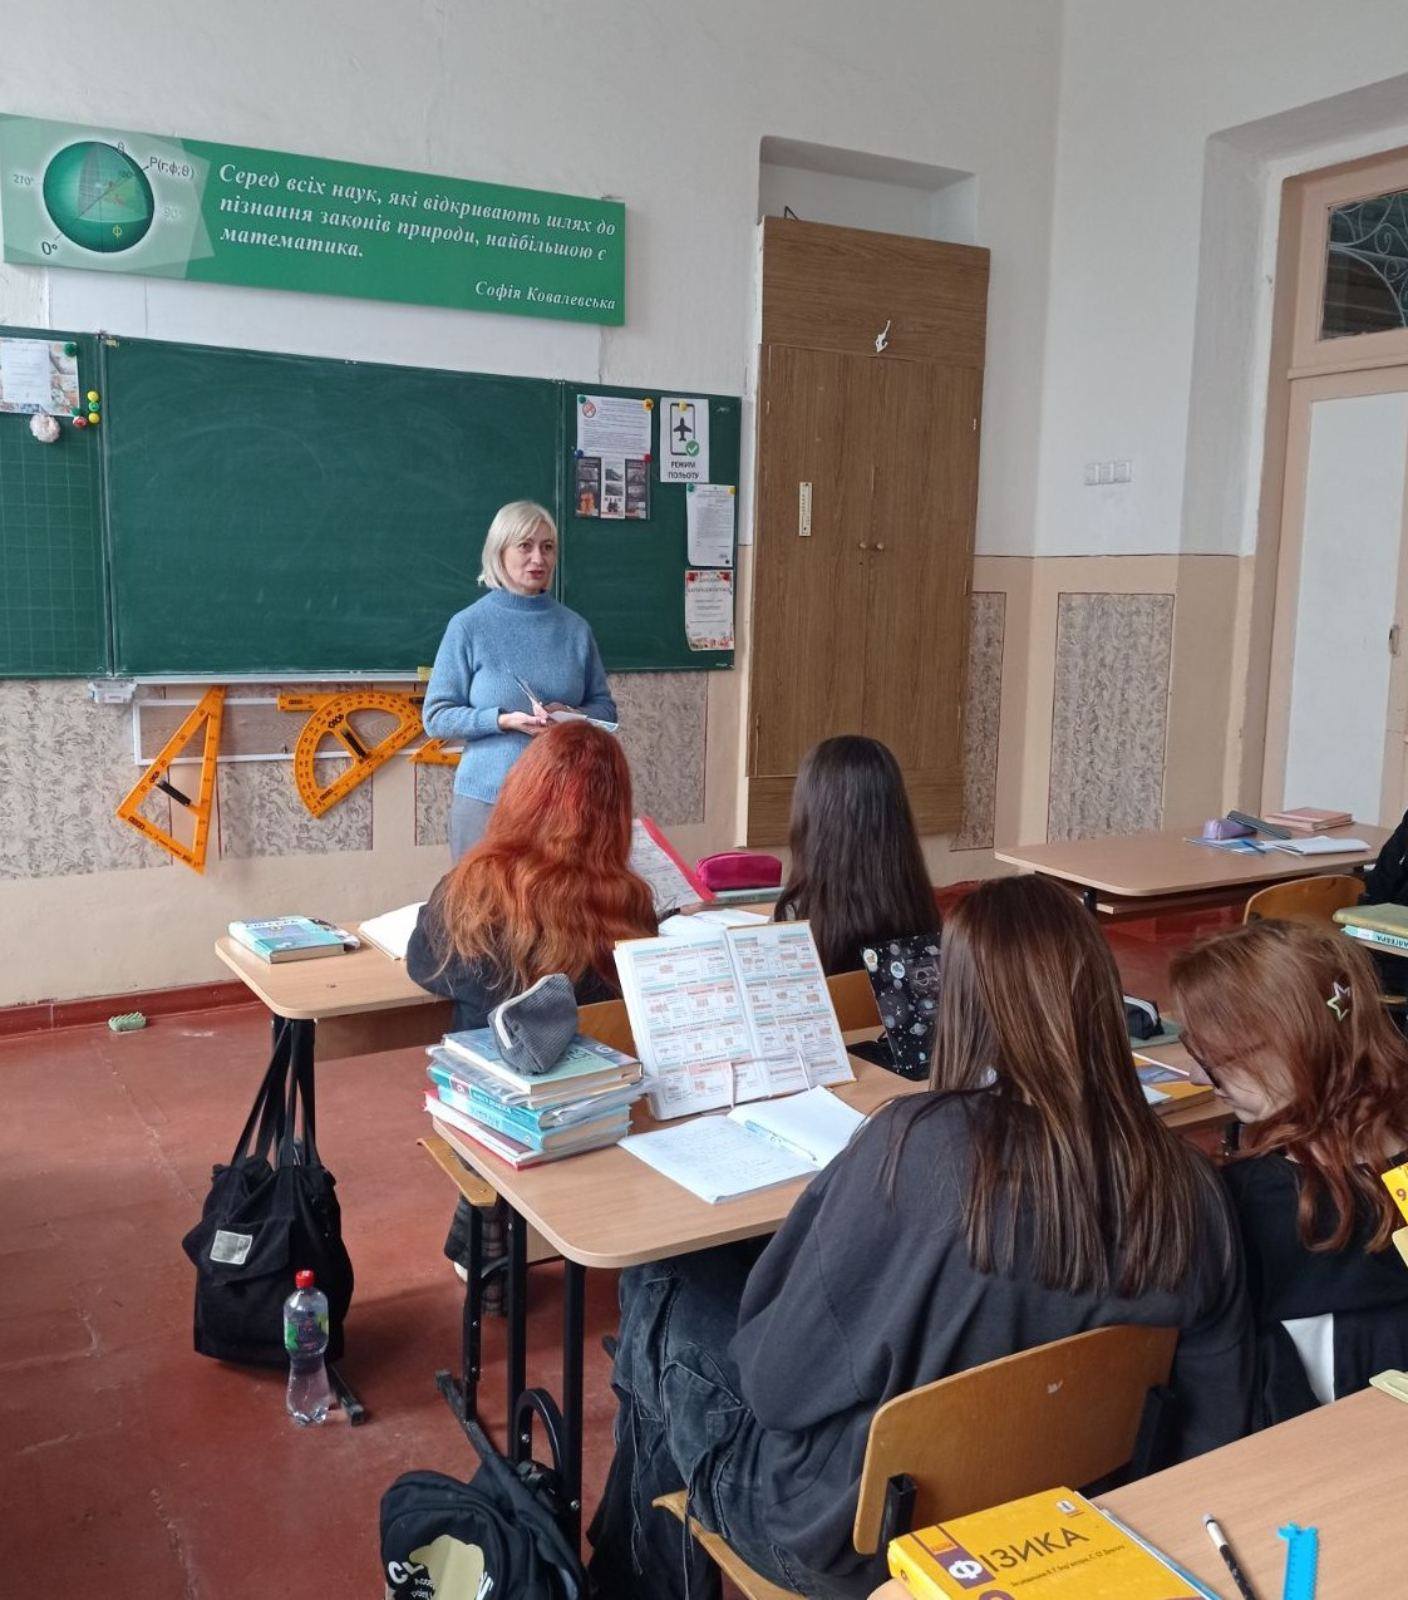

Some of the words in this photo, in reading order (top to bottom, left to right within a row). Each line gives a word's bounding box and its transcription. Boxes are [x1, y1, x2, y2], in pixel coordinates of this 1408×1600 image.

[219, 163, 281, 190] Серед
[286, 176, 327, 195] всіх
[332, 183, 382, 205] наук,
[388, 191, 418, 208] які
[423, 193, 541, 225] відкривають
[546, 213, 593, 233] шлях
[597, 222, 616, 236] до
[220, 195, 314, 223] пізнання
[320, 211, 392, 233] законів
[397, 220, 480, 247] природи,
[486, 232, 593, 261] найбільшою
[597, 247, 608, 261] є
[220, 228, 364, 258] математика.
[475, 281, 522, 302] Софія
[526, 286, 616, 311] Ковалевська
[949, 1527, 1090, 1580] ФІЗИКА
